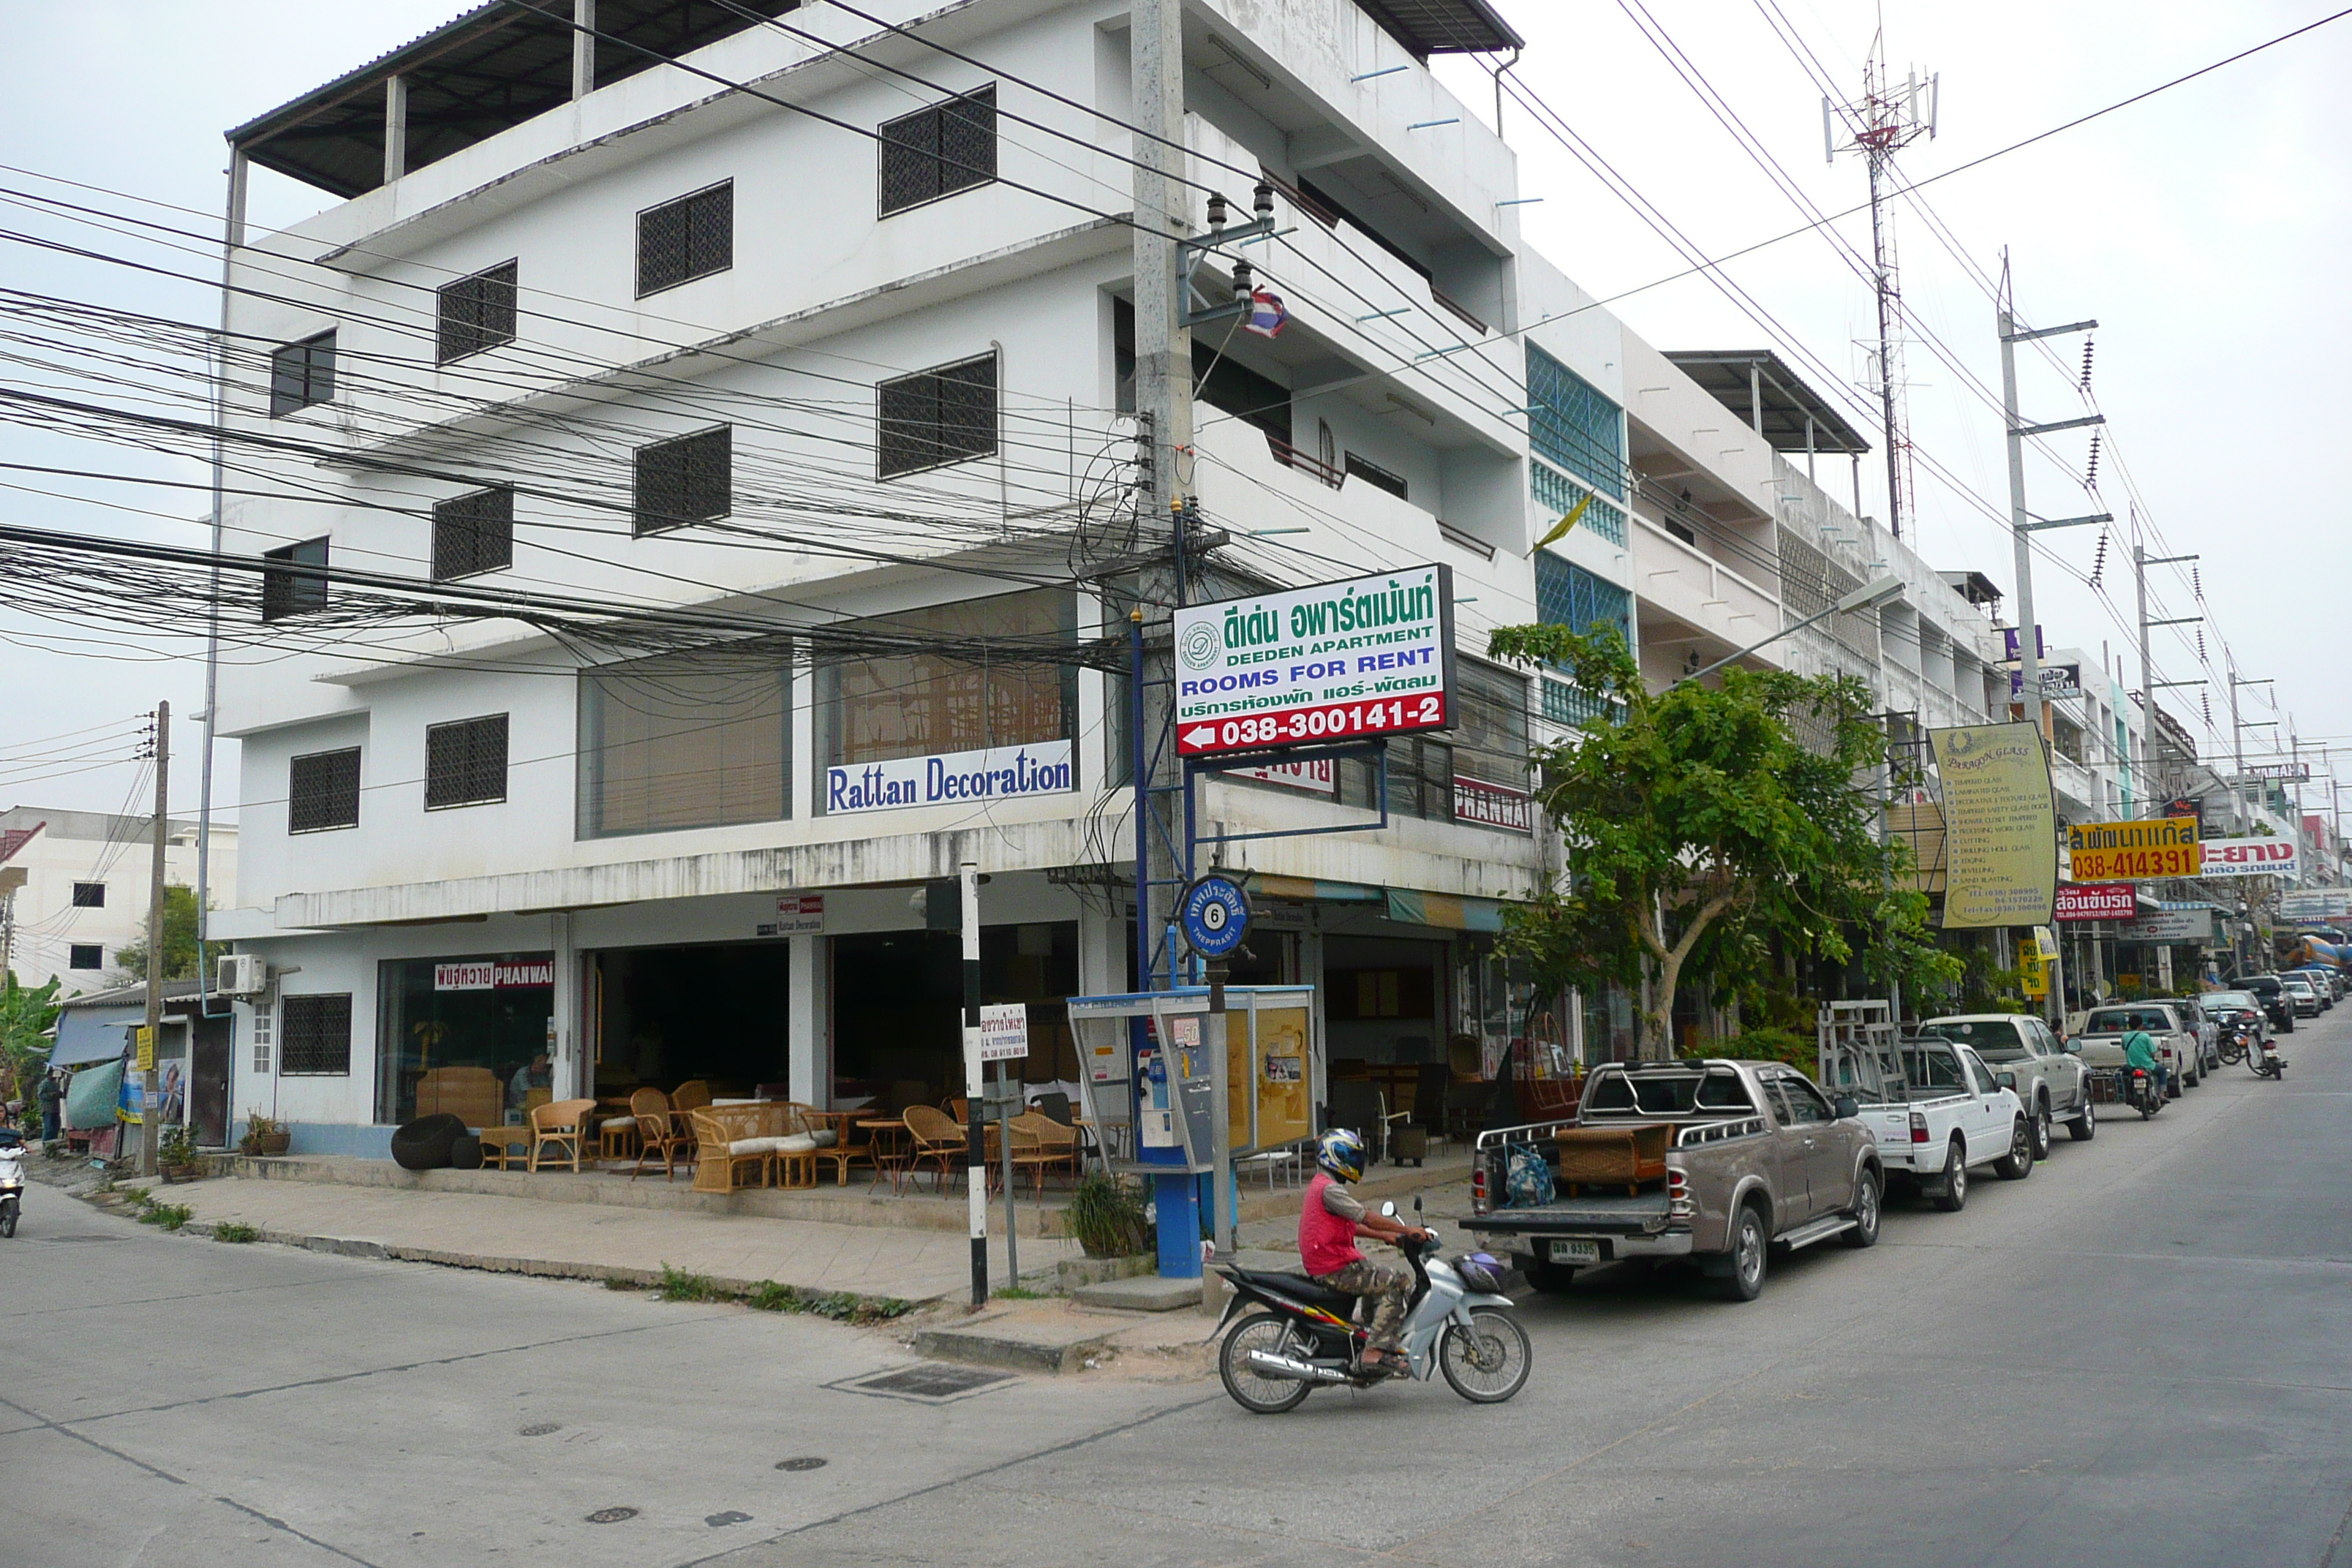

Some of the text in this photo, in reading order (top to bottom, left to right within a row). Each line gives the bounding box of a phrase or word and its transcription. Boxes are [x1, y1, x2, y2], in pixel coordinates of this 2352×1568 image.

[1224, 606, 1279, 649] ดีเด่น
[1226, 625, 1434, 667] DEEDEN APARTMENT
[1181, 647, 1435, 697] ROOMS FOR RENT
[1180, 674, 1437, 717] บริการห้องพัก แอร์-พัดลม
[1222, 697, 1440, 745] 038-300141-2
[1948, 747, 2029, 770] PARAGON GLASS
[828, 747, 1071, 811] Rattan Decoration
[2073, 849, 2191, 878] 038-414391
[2201, 863, 2236, 875] งล้อ
[2056, 891, 2132, 910] สอนขับรถ
[1211, 909, 1219, 923] 6
[1194, 926, 1236, 946] THEPPRASIT
[1183, 1025, 1199, 1042] 50
